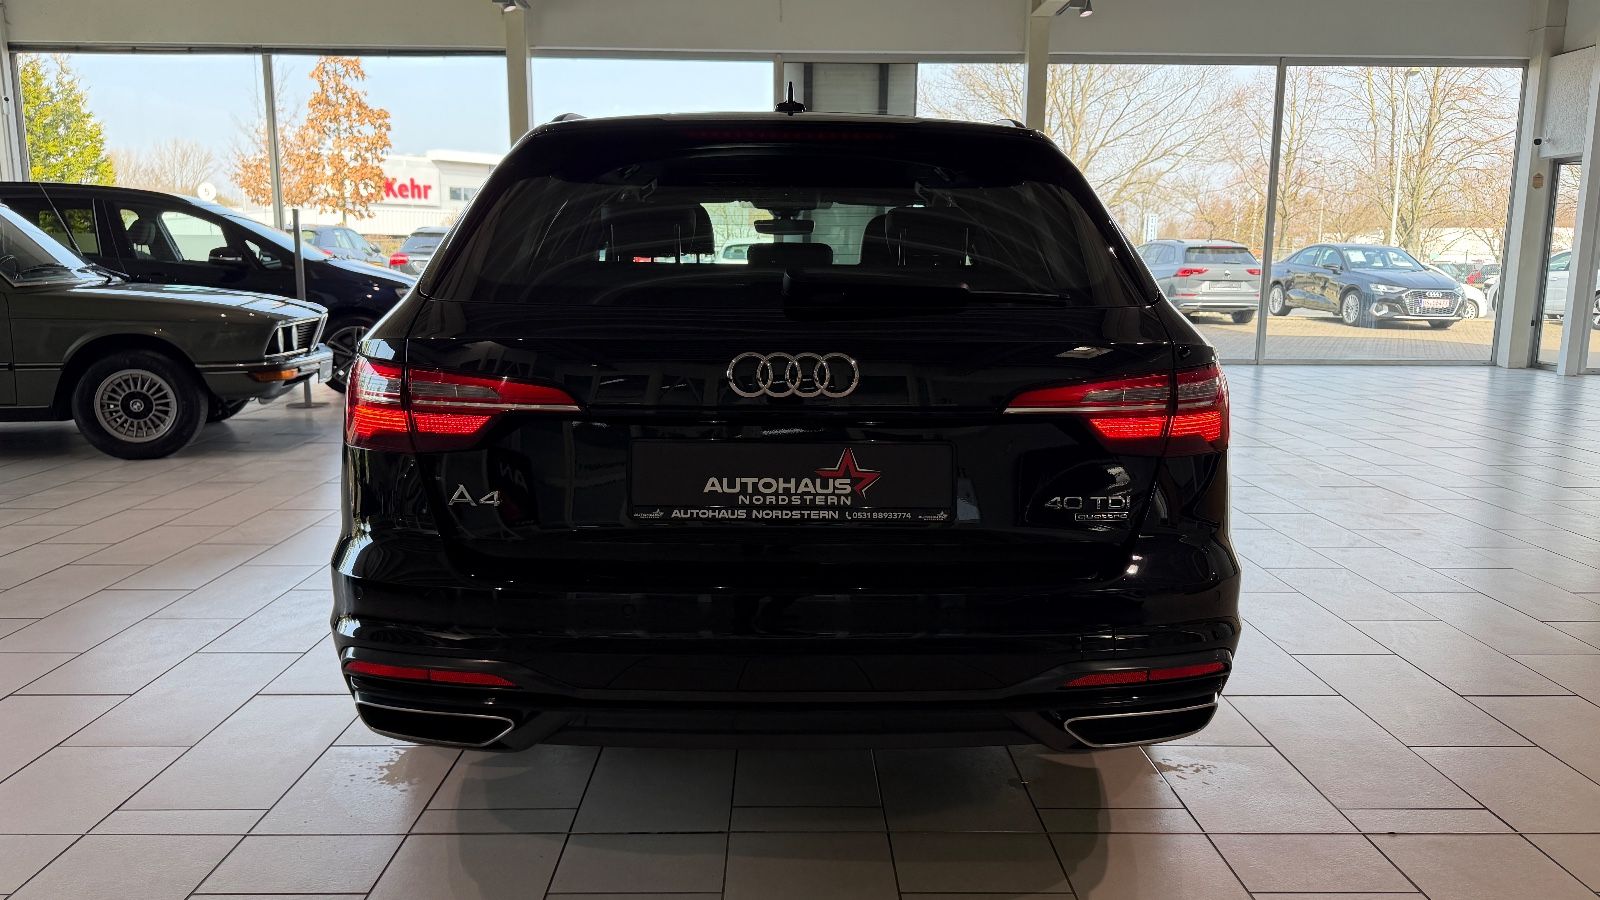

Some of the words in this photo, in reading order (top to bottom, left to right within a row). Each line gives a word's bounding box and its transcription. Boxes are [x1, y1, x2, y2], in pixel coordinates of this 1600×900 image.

[384, 177, 432, 199] Kehr
[703, 477, 852, 494] AUTOHAUS
[448, 483, 502, 507] A4
[738, 495, 852, 506] NORDSTERN
[1044, 496, 1083, 510] 40
[1089, 495, 1131, 510] TDI
[671, 509, 747, 519] AUTOHAUS
[752, 509, 839, 519] NORDSTERN
[1077, 513, 1128, 521] quattro
